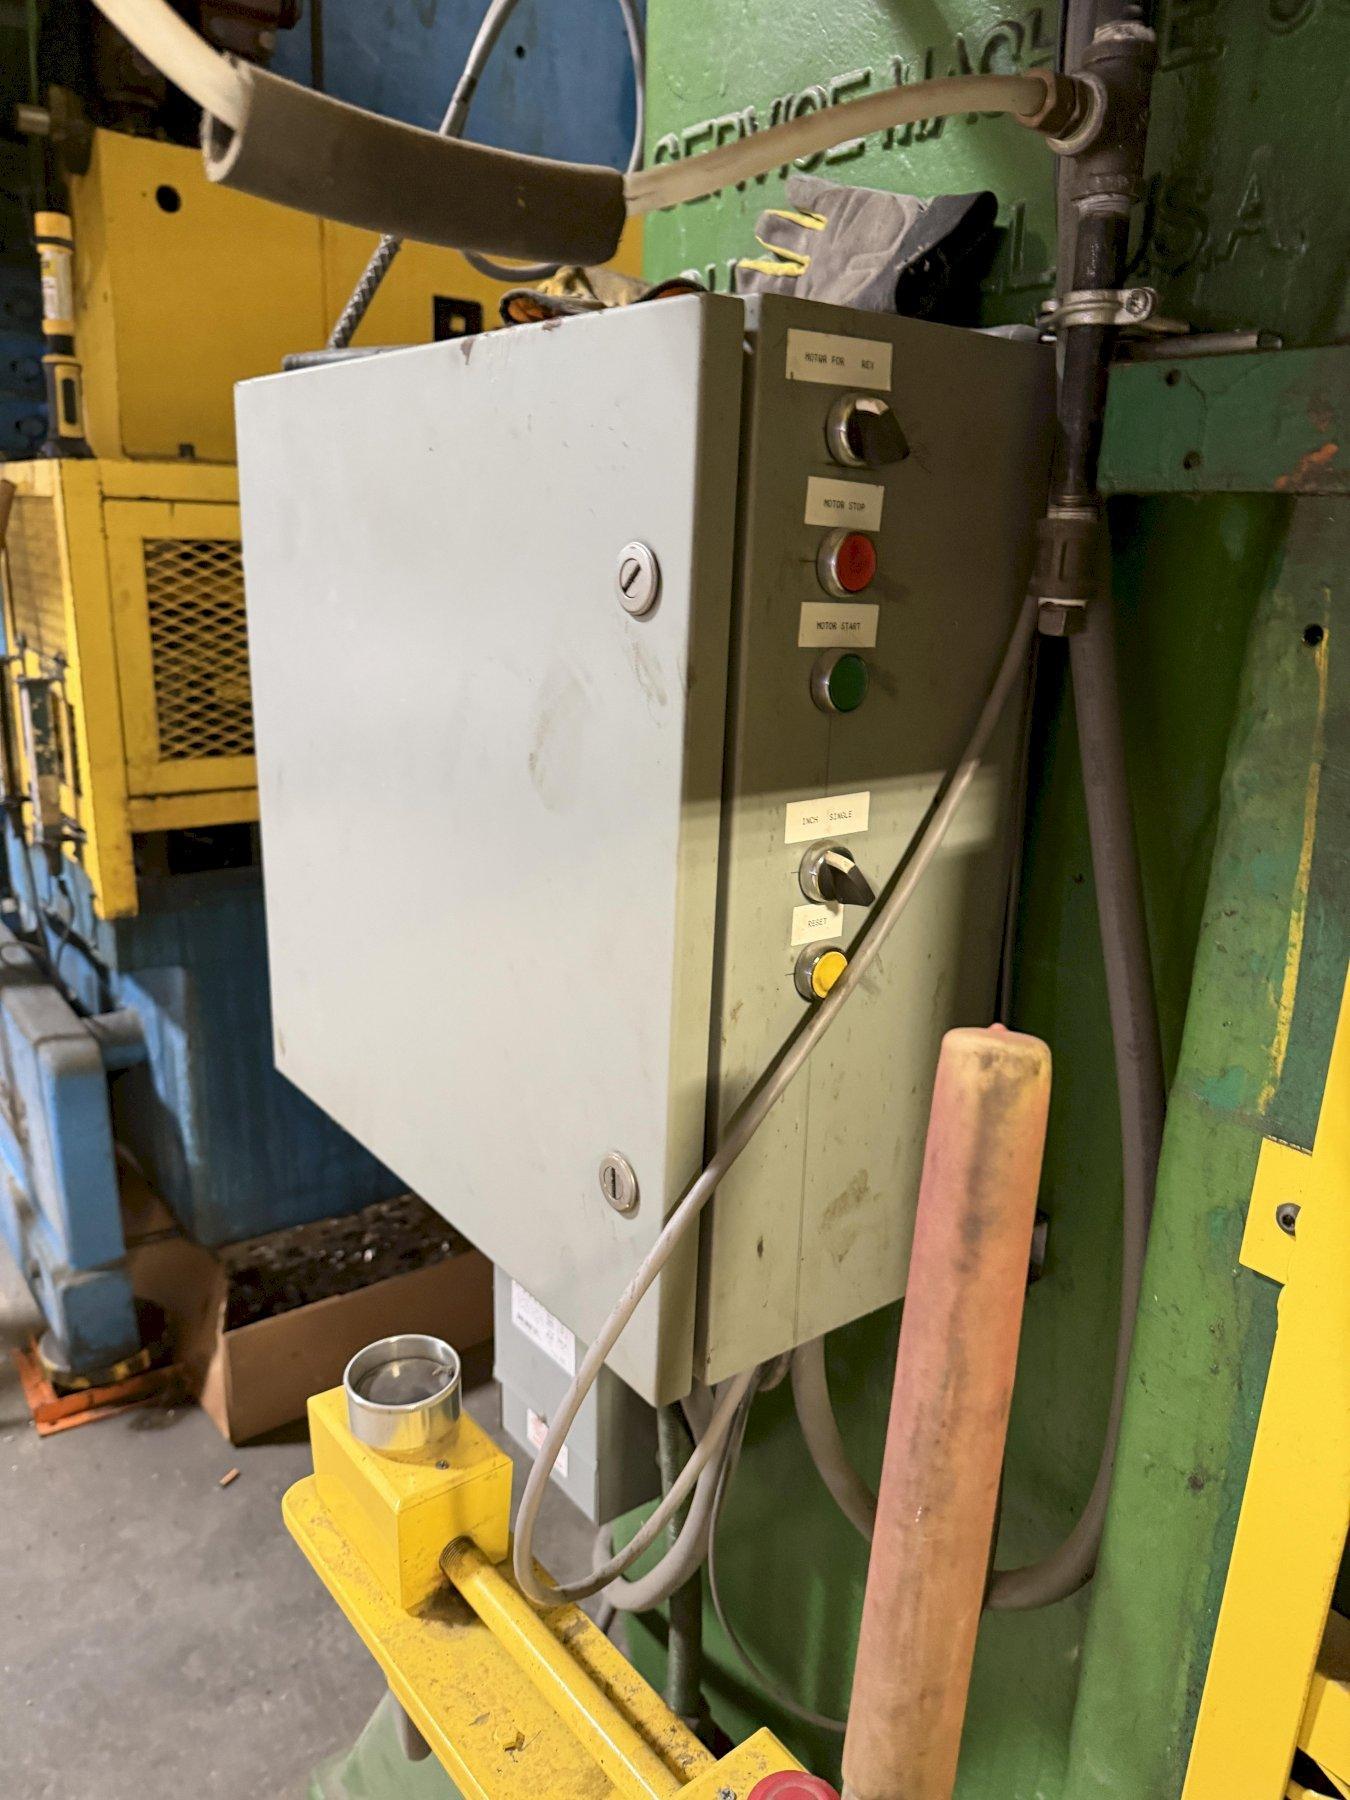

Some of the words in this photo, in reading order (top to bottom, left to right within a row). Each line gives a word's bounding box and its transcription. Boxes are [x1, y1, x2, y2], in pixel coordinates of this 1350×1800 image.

[824, 498, 844, 510] MOTOR
[848, 500, 865, 511] STOP
[817, 620, 836, 631] MOTOR
[840, 621, 861, 631] START
[802, 815, 819, 826] INCH
[829, 810, 852, 821] SINGLE
[808, 917, 828, 928] RESET
